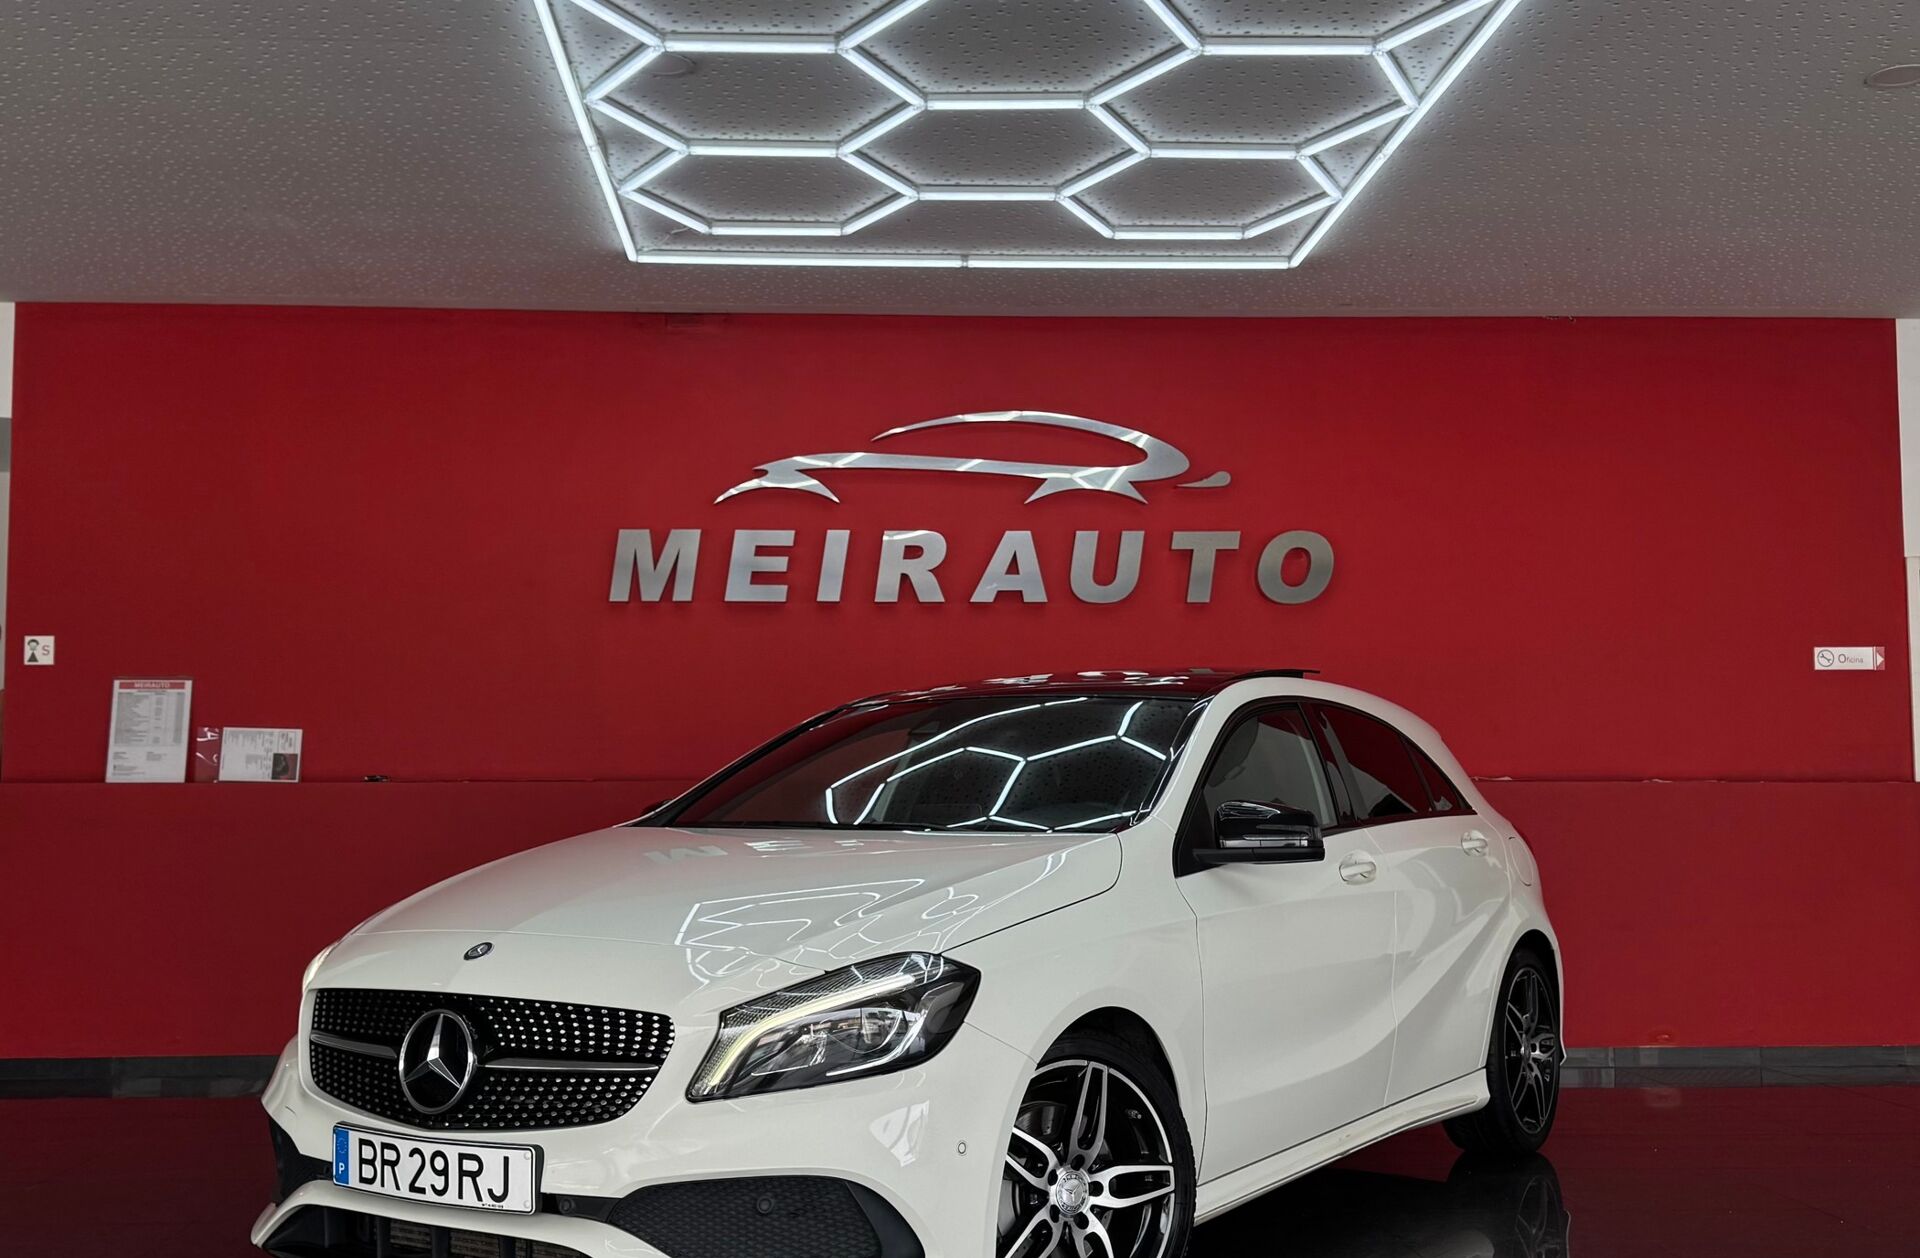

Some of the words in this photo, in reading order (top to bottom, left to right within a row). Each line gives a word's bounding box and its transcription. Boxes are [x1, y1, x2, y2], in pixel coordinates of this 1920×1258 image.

[609, 528, 1335, 604] MEIRAUTO
[42, 645, 50, 656] S
[1838, 653, 1864, 664] Oficina
[339, 1163, 345, 1174] P
